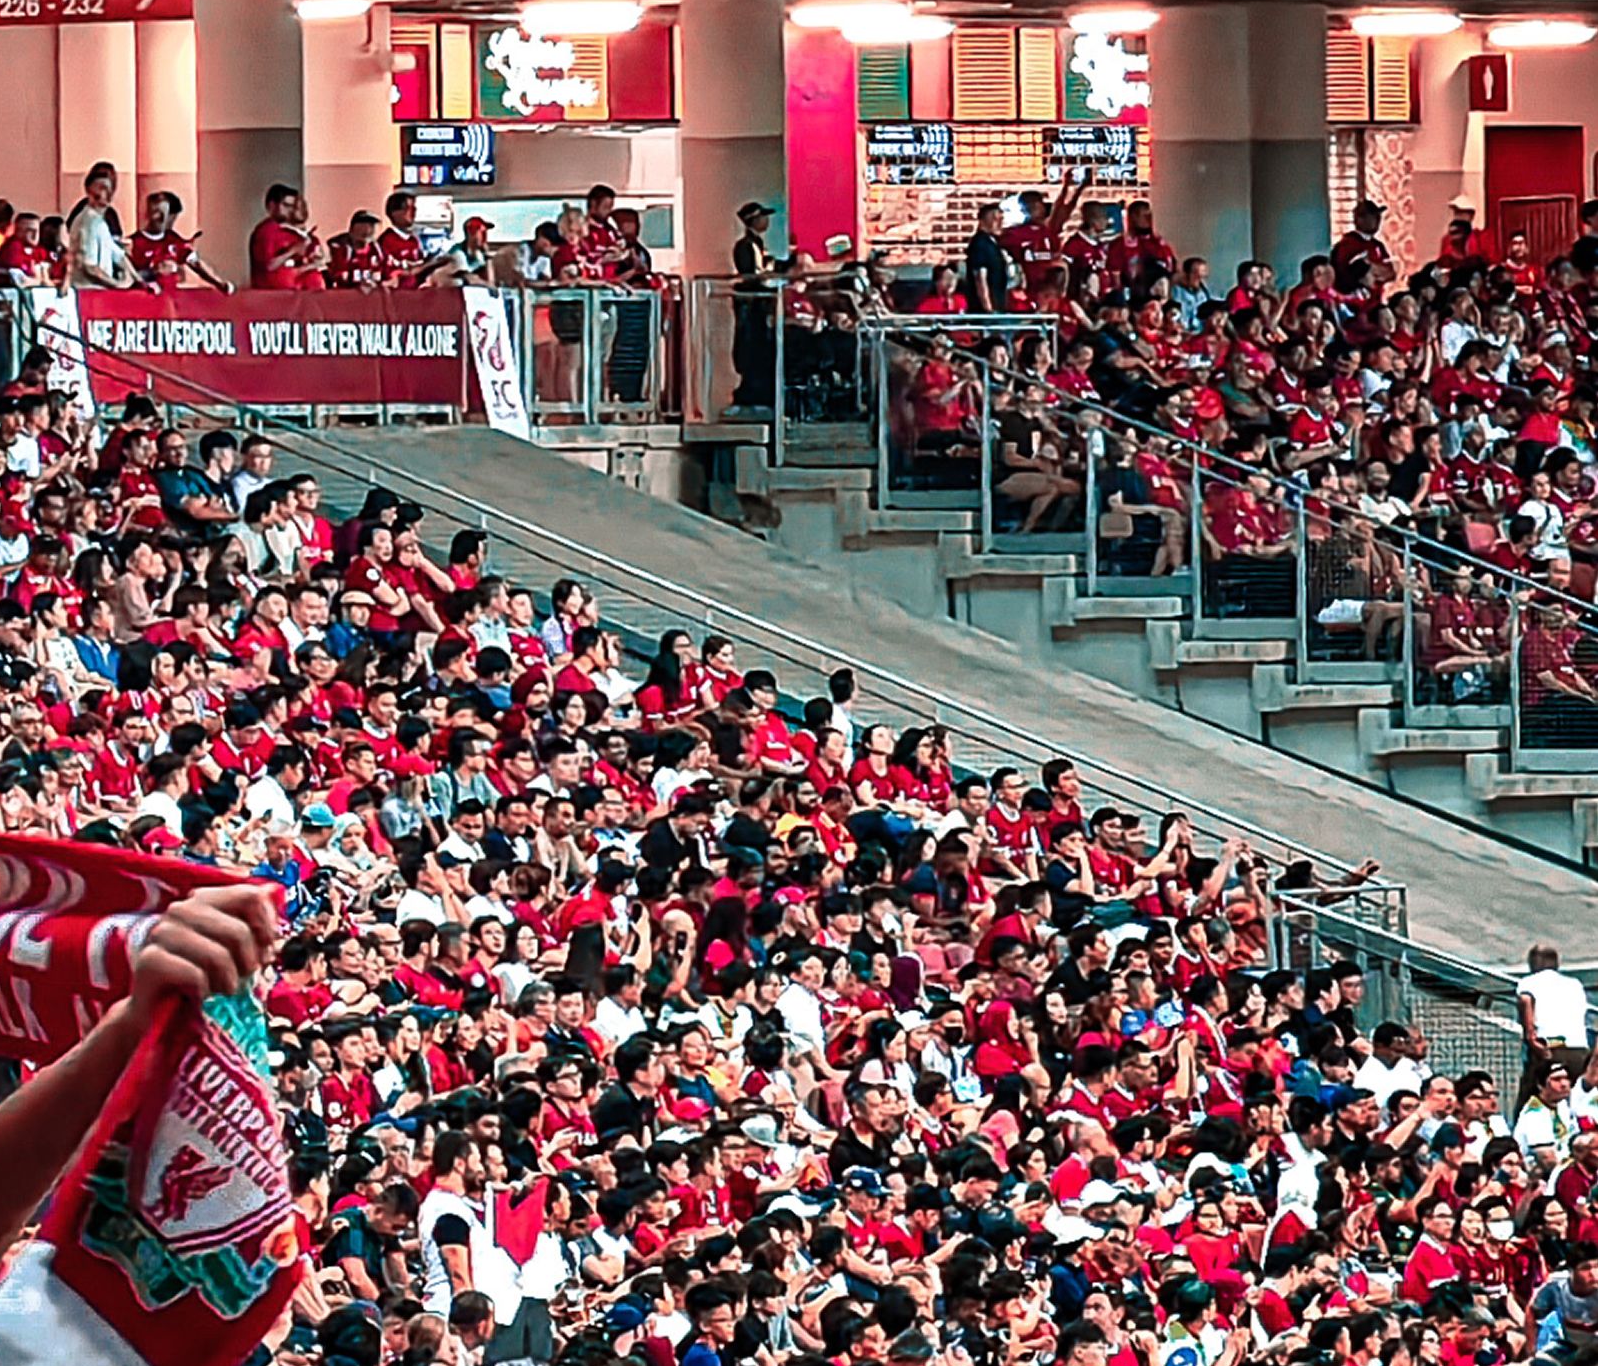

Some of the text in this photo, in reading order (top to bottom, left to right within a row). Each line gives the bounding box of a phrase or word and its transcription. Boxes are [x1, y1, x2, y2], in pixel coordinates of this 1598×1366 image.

[87, 319, 459, 357] WE ARE LIVERPOOL YOU'LL NEVER WALK ALONE
